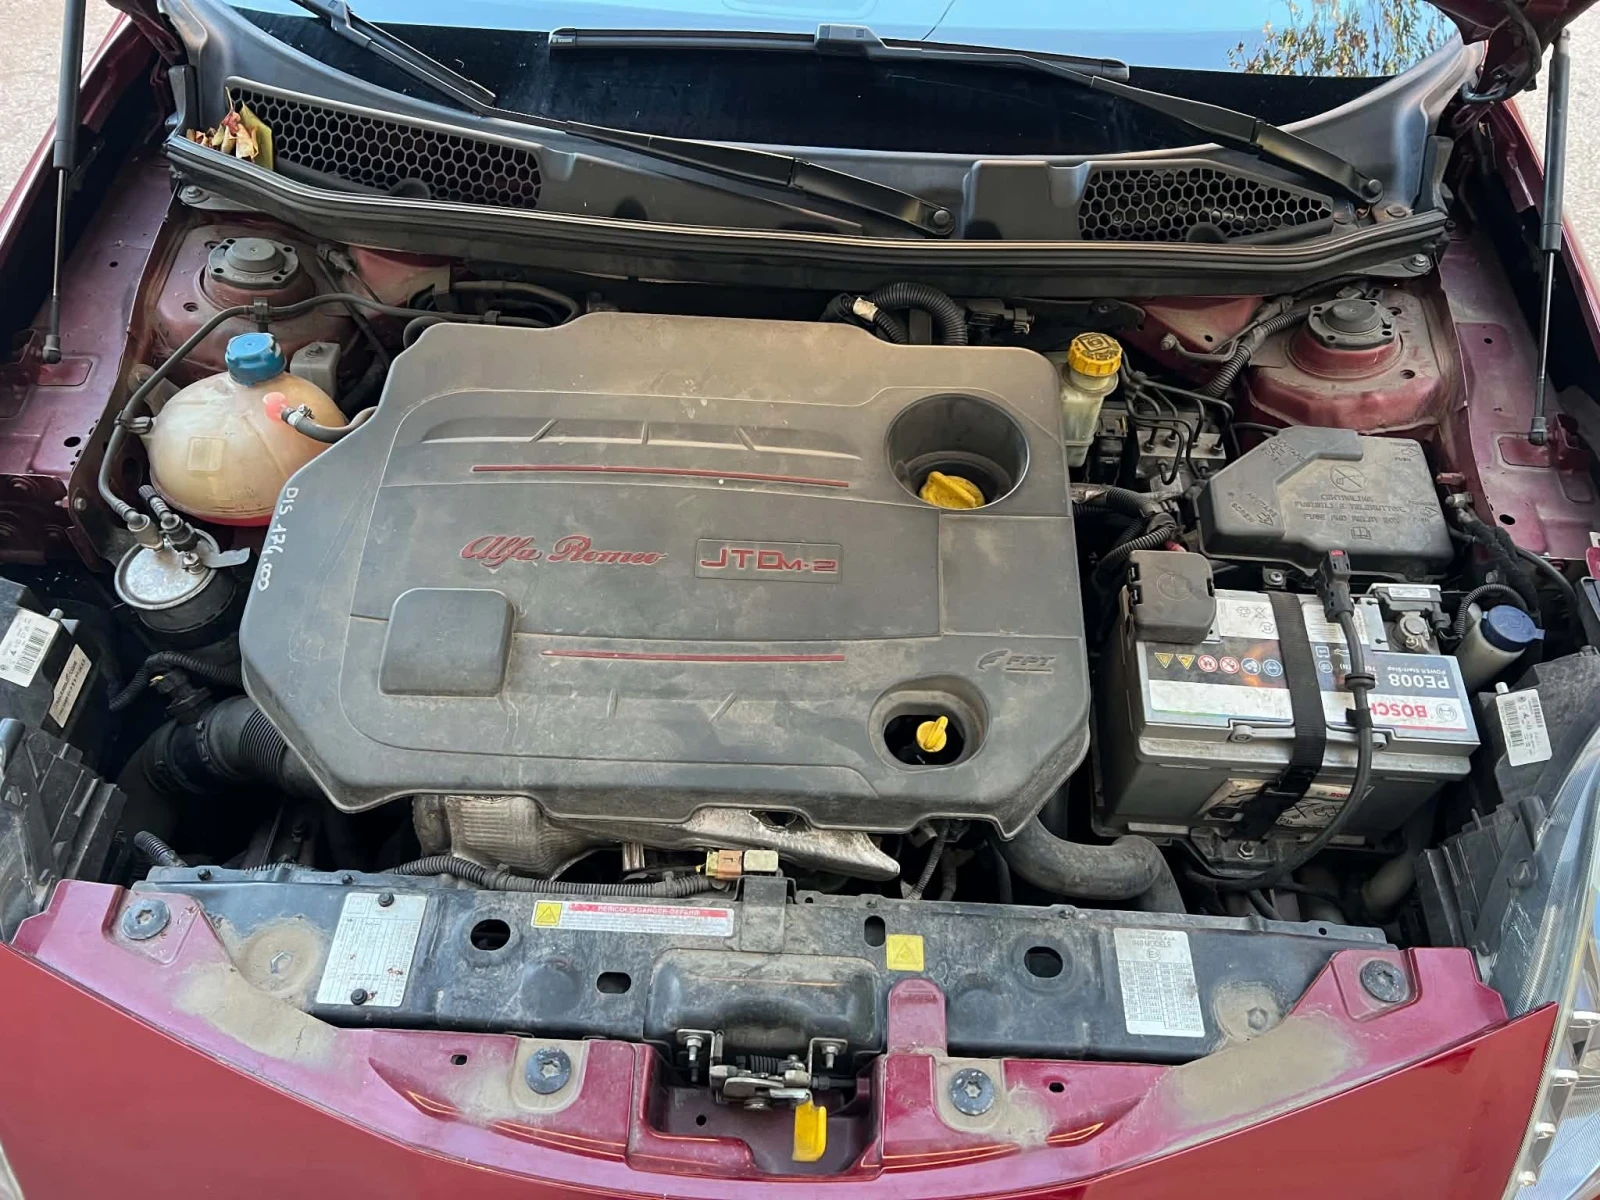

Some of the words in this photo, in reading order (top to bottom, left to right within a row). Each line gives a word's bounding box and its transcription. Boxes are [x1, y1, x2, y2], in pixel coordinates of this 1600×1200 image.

[459, 535, 543, 568] Alfa
[548, 534, 668, 567] Romeo
[1005, 655, 1055, 667] FPT
[1420, 667, 1446, 675] POWER
[1387, 673, 1451, 689] PE008
